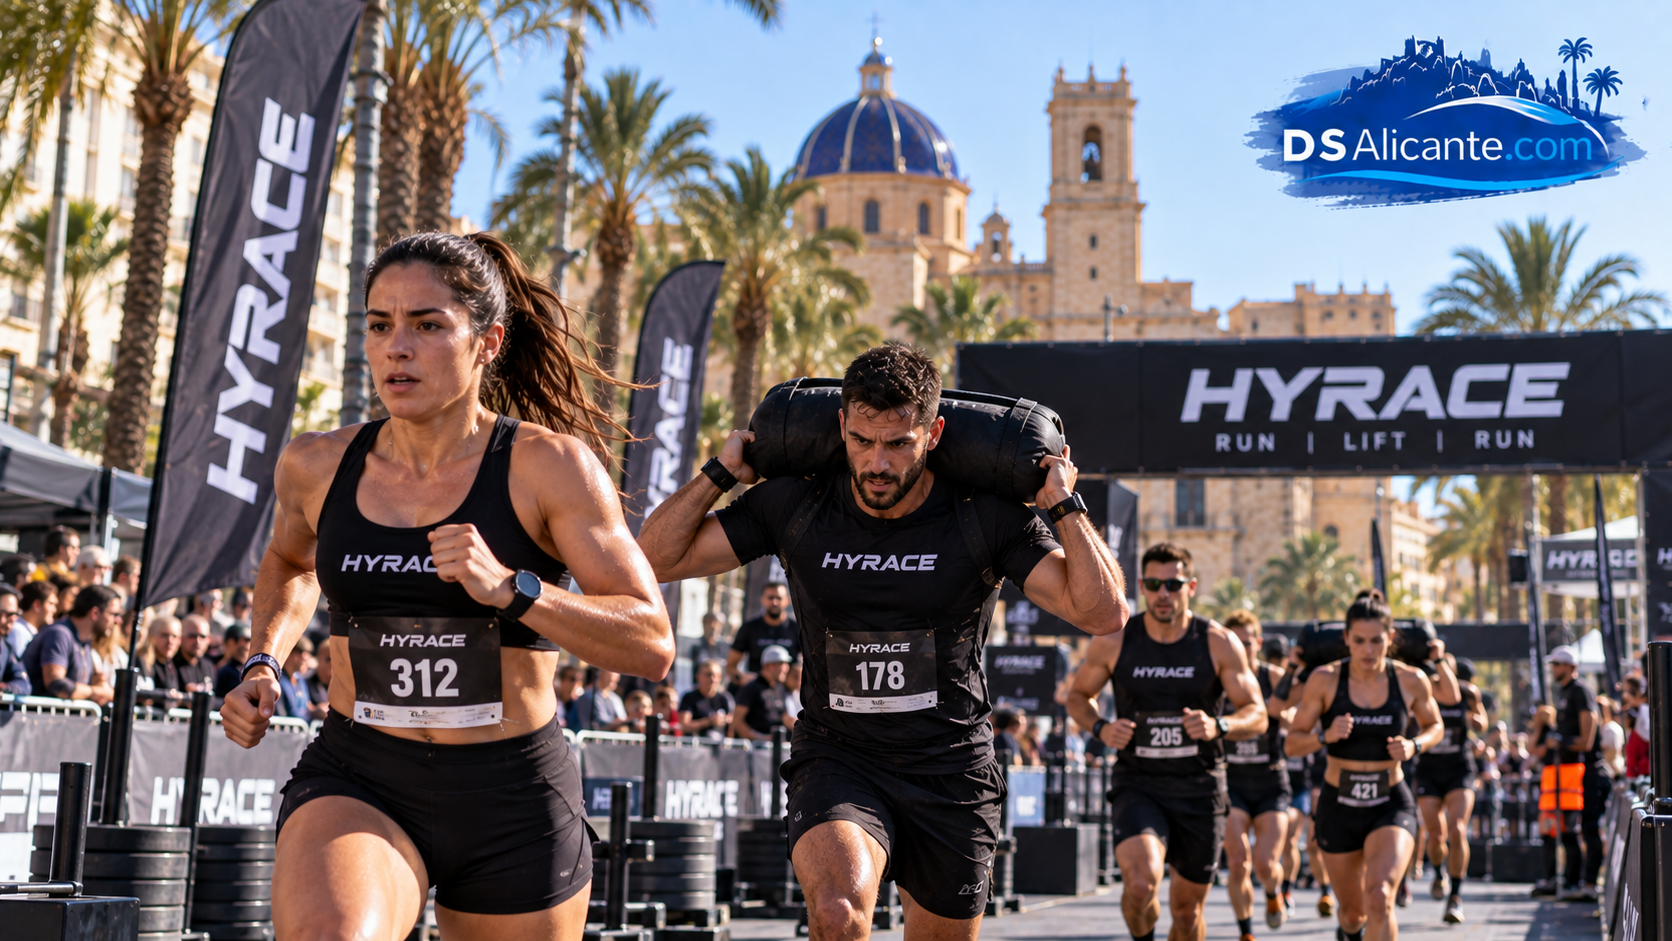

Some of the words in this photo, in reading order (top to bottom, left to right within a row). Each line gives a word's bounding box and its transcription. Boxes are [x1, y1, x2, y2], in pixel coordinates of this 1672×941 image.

[206, 96, 316, 505] HYRACE
[1180, 361, 1571, 423] HYRACE
[1215, 432, 1276, 453] RUN
[1343, 431, 1407, 452] LIFT
[1474, 429, 1535, 450] RUN
[341, 554, 437, 573] HYRAC
[821, 552, 938, 572] HYRACE
[379, 633, 467, 648] HYRACE
[849, 642, 911, 653] HYRACE
[389, 658, 459, 698] 312
[855, 660, 905, 691] 178
[1132, 666, 1195, 679] HYRACE
[1353, 715, 1393, 725] YRACE
[1150, 727, 1183, 747] 205
[1351, 782, 1378, 800] 421
